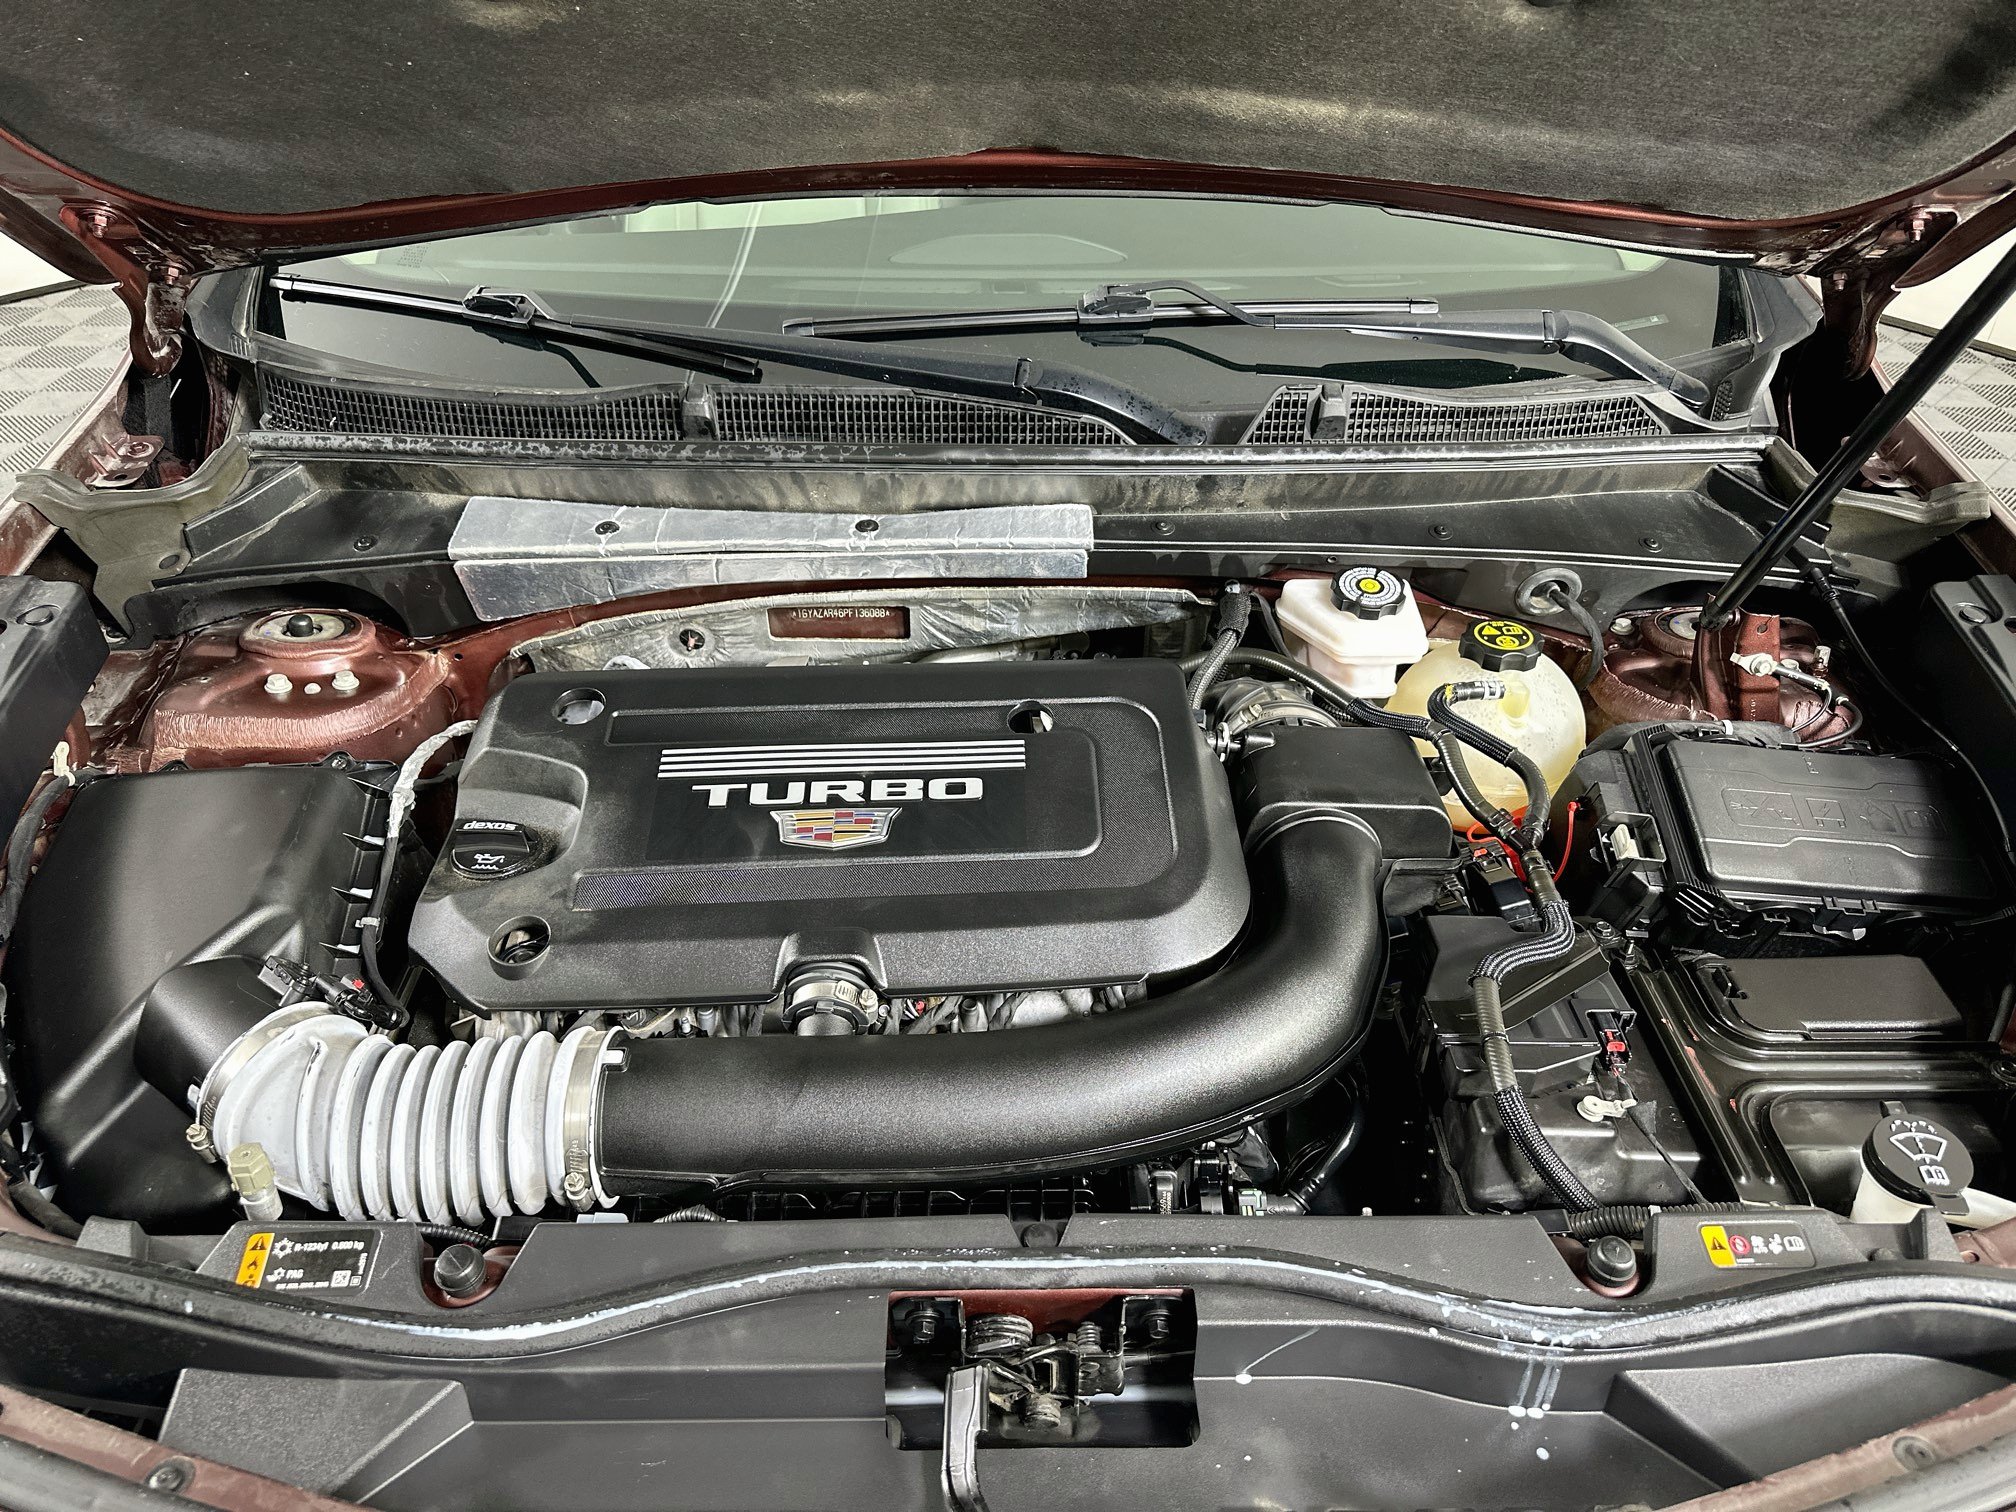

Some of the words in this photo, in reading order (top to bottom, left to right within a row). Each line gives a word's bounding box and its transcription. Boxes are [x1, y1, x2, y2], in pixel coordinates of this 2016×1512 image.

[692, 777, 983, 808] TURBO
[463, 821, 518, 831] dexos
[286, 1269, 304, 1279] PAG
